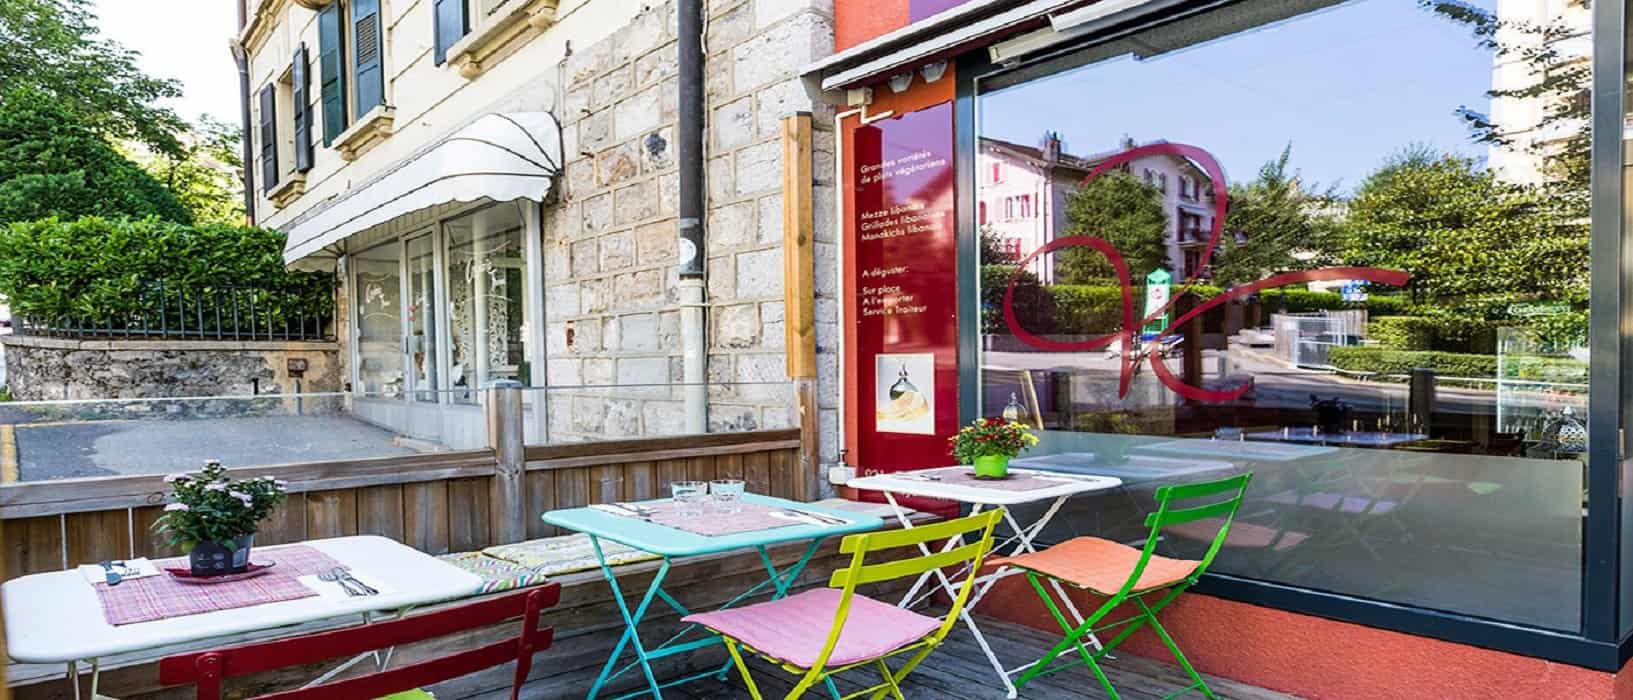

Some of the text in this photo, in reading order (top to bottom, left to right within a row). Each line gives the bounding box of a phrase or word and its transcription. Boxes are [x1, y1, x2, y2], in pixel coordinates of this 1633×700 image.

[860, 176, 871, 184] de
[861, 210, 888, 219] Mezze
[861, 218, 898, 231] Grillades
[862, 285, 901, 295] Sur place
[863, 307, 893, 316] Service
